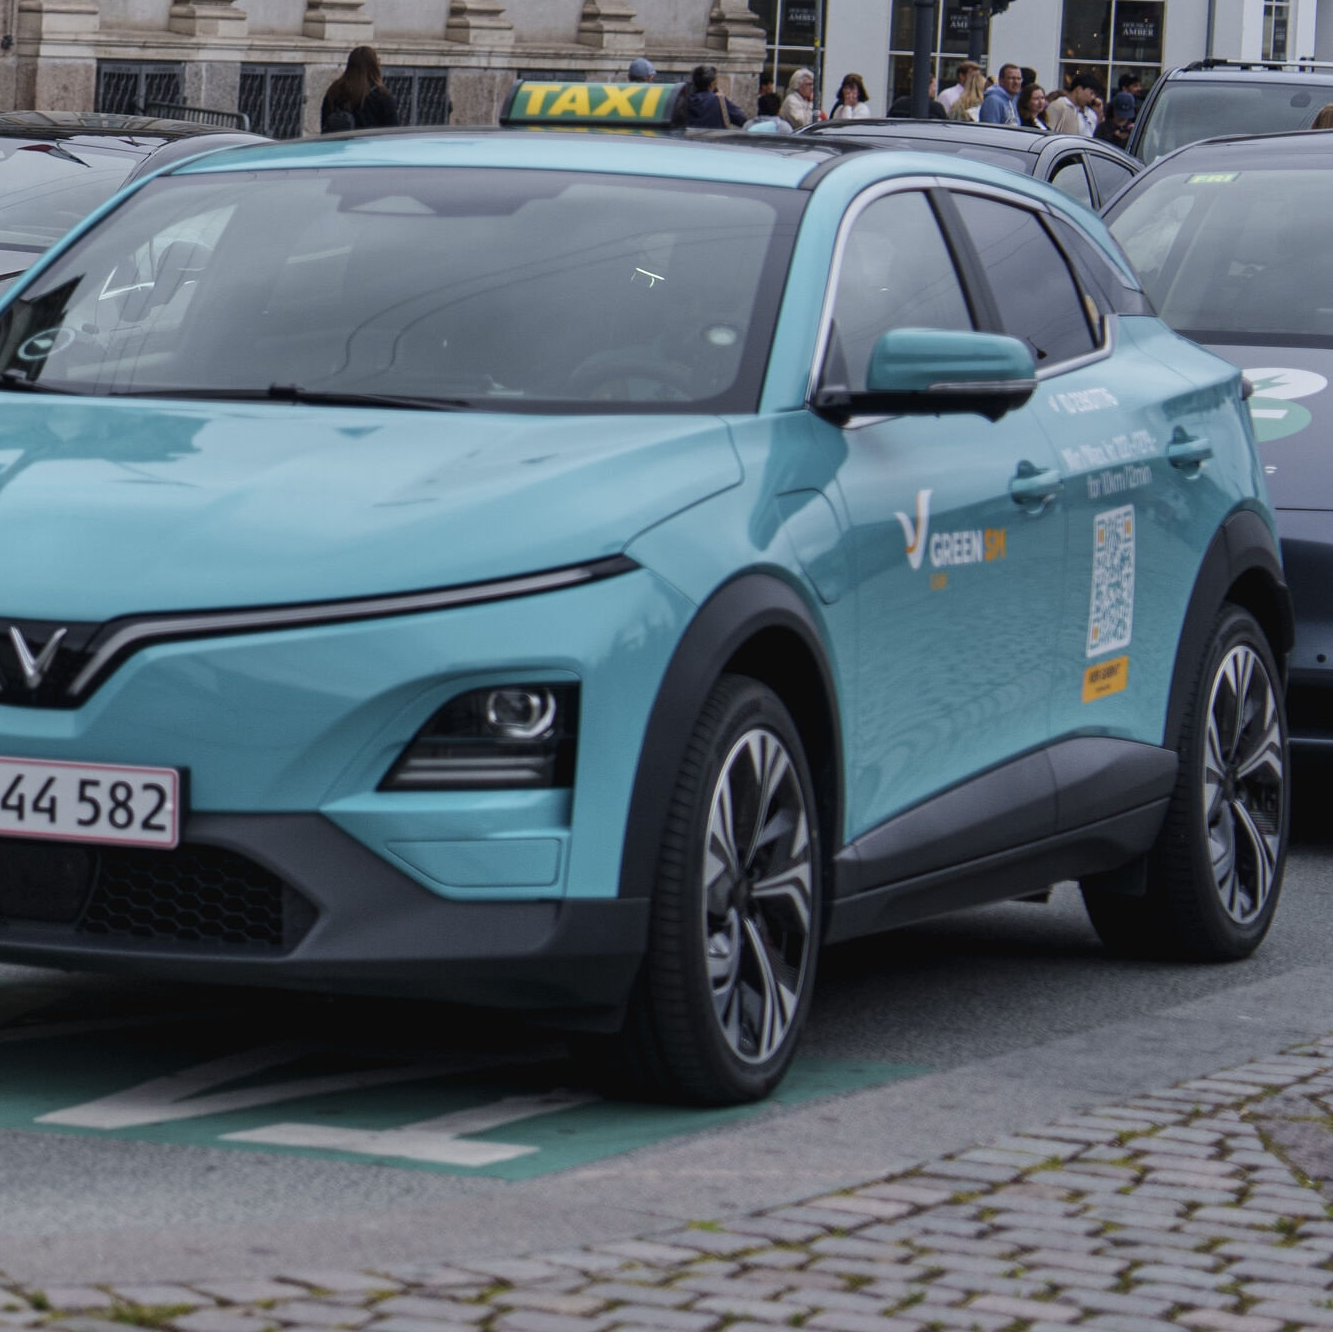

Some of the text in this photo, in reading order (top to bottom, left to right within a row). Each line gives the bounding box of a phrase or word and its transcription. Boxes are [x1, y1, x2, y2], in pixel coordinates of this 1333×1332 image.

[1122, 28, 1154, 37] AMBER
[521, 84, 664, 118] TAXI
[929, 529, 984, 568] GREEN
[0, 773, 57, 823] 44
[76, 777, 167, 832] 582
